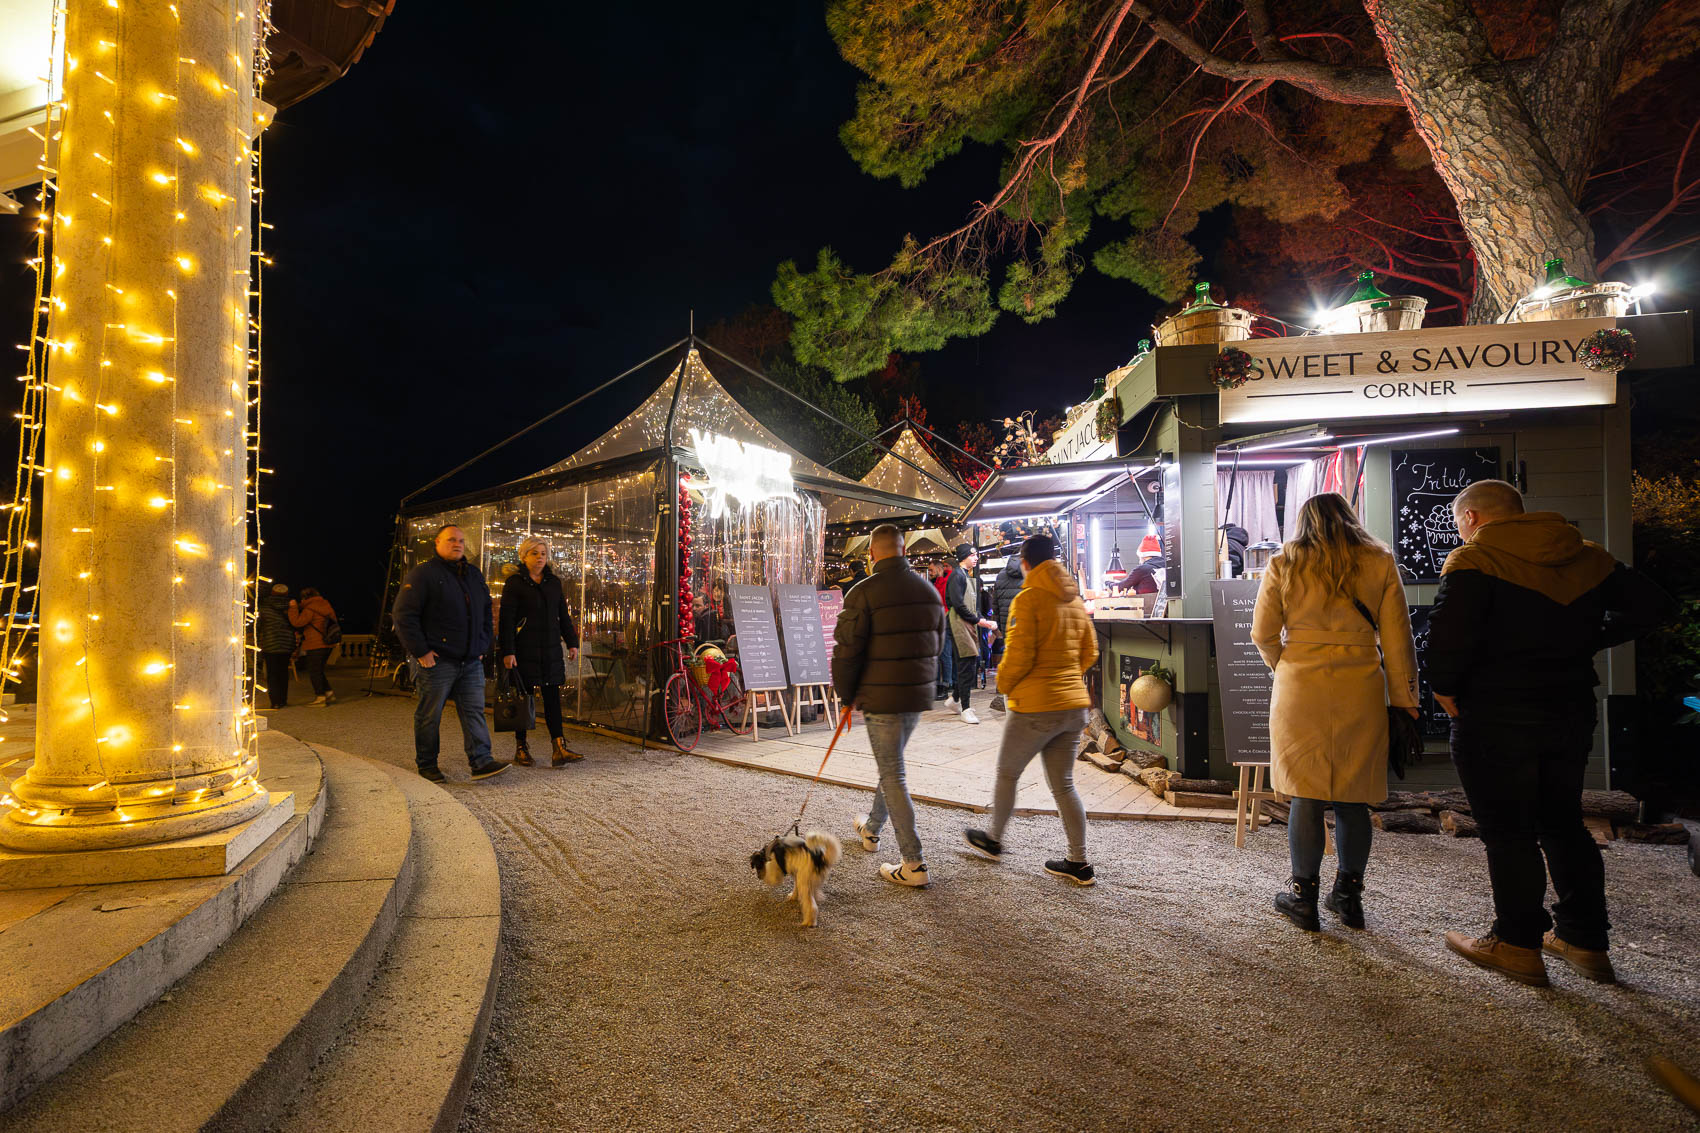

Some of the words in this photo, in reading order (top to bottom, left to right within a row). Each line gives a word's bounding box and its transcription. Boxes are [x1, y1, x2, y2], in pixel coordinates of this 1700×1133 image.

[1249, 351, 1364, 381] SWEET
[1376, 350, 1400, 374] &
[1411, 338, 1586, 372] SAVOURY
[1363, 380, 1457, 400] CORNER
[1075, 417, 1097, 454] JACO
[1412, 462, 1471, 491] Fritule
